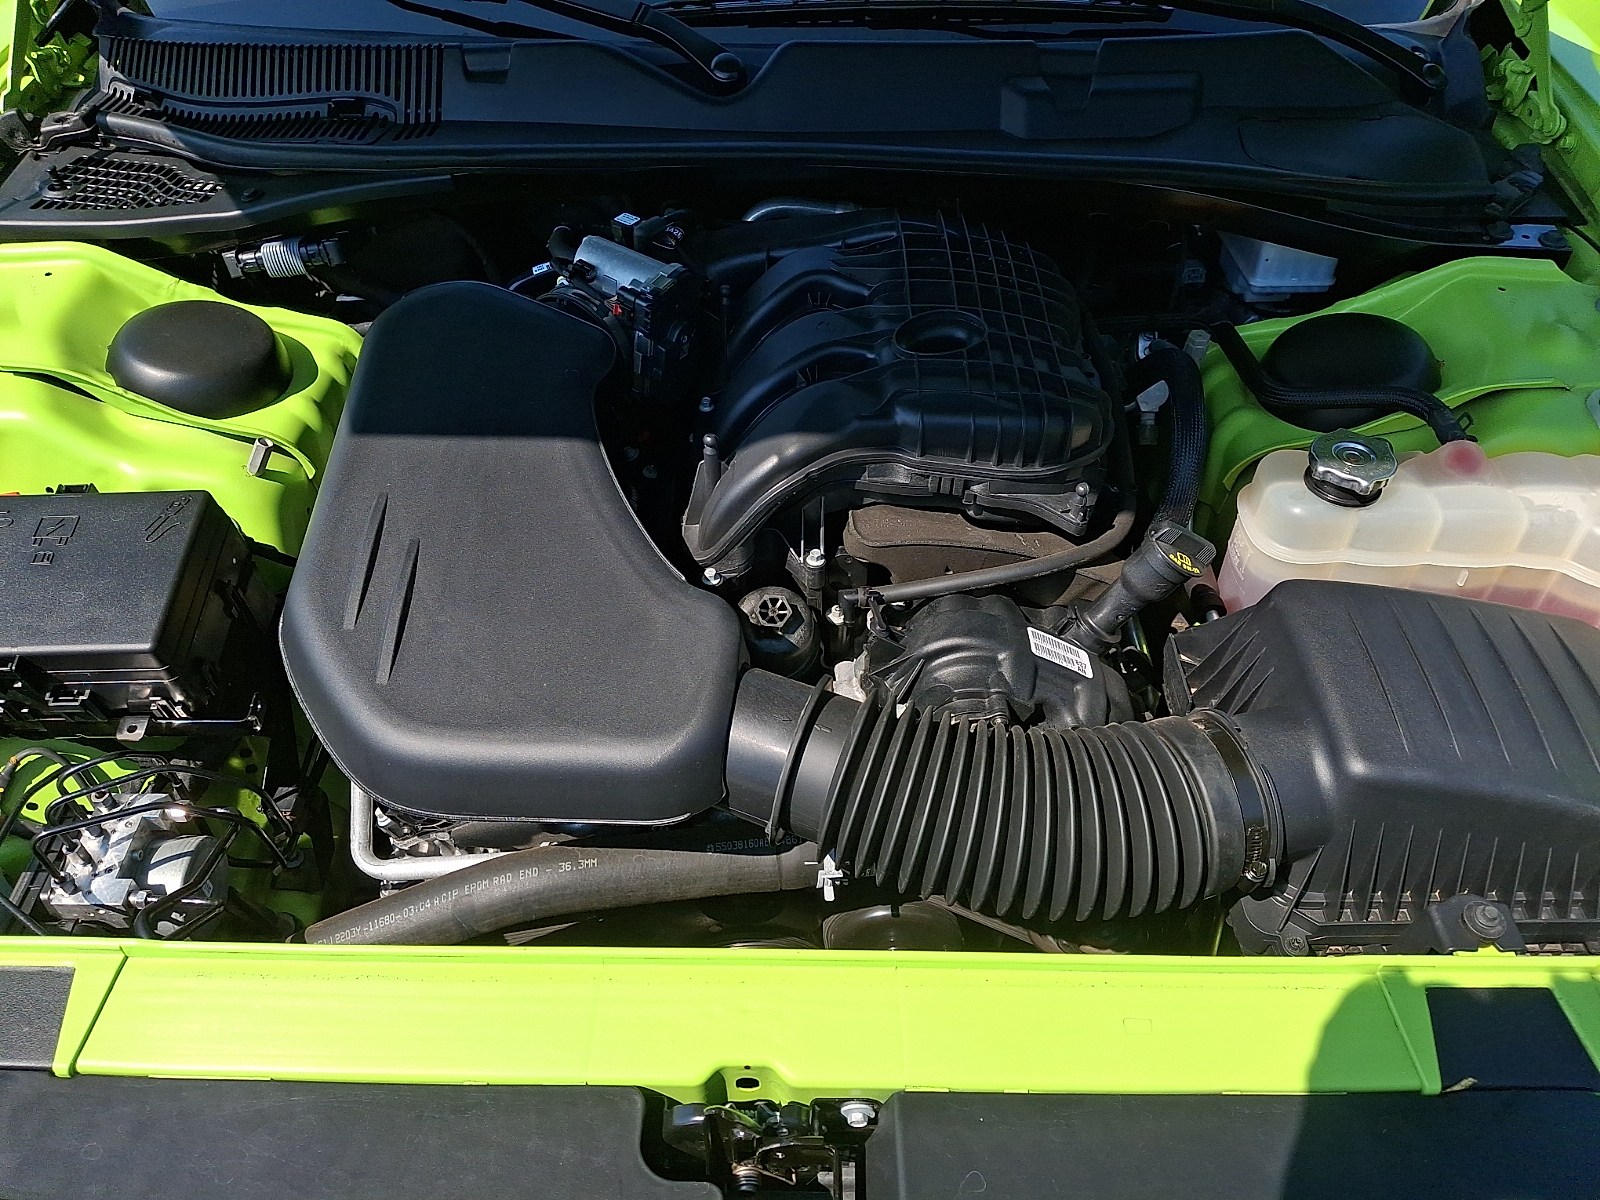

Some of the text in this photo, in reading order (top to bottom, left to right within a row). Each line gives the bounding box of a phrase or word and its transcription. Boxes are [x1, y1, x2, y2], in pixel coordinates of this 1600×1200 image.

[493, 872, 512, 886] RAD
[519, 866, 539, 880] END
[558, 857, 598, 873] 36.3MM
